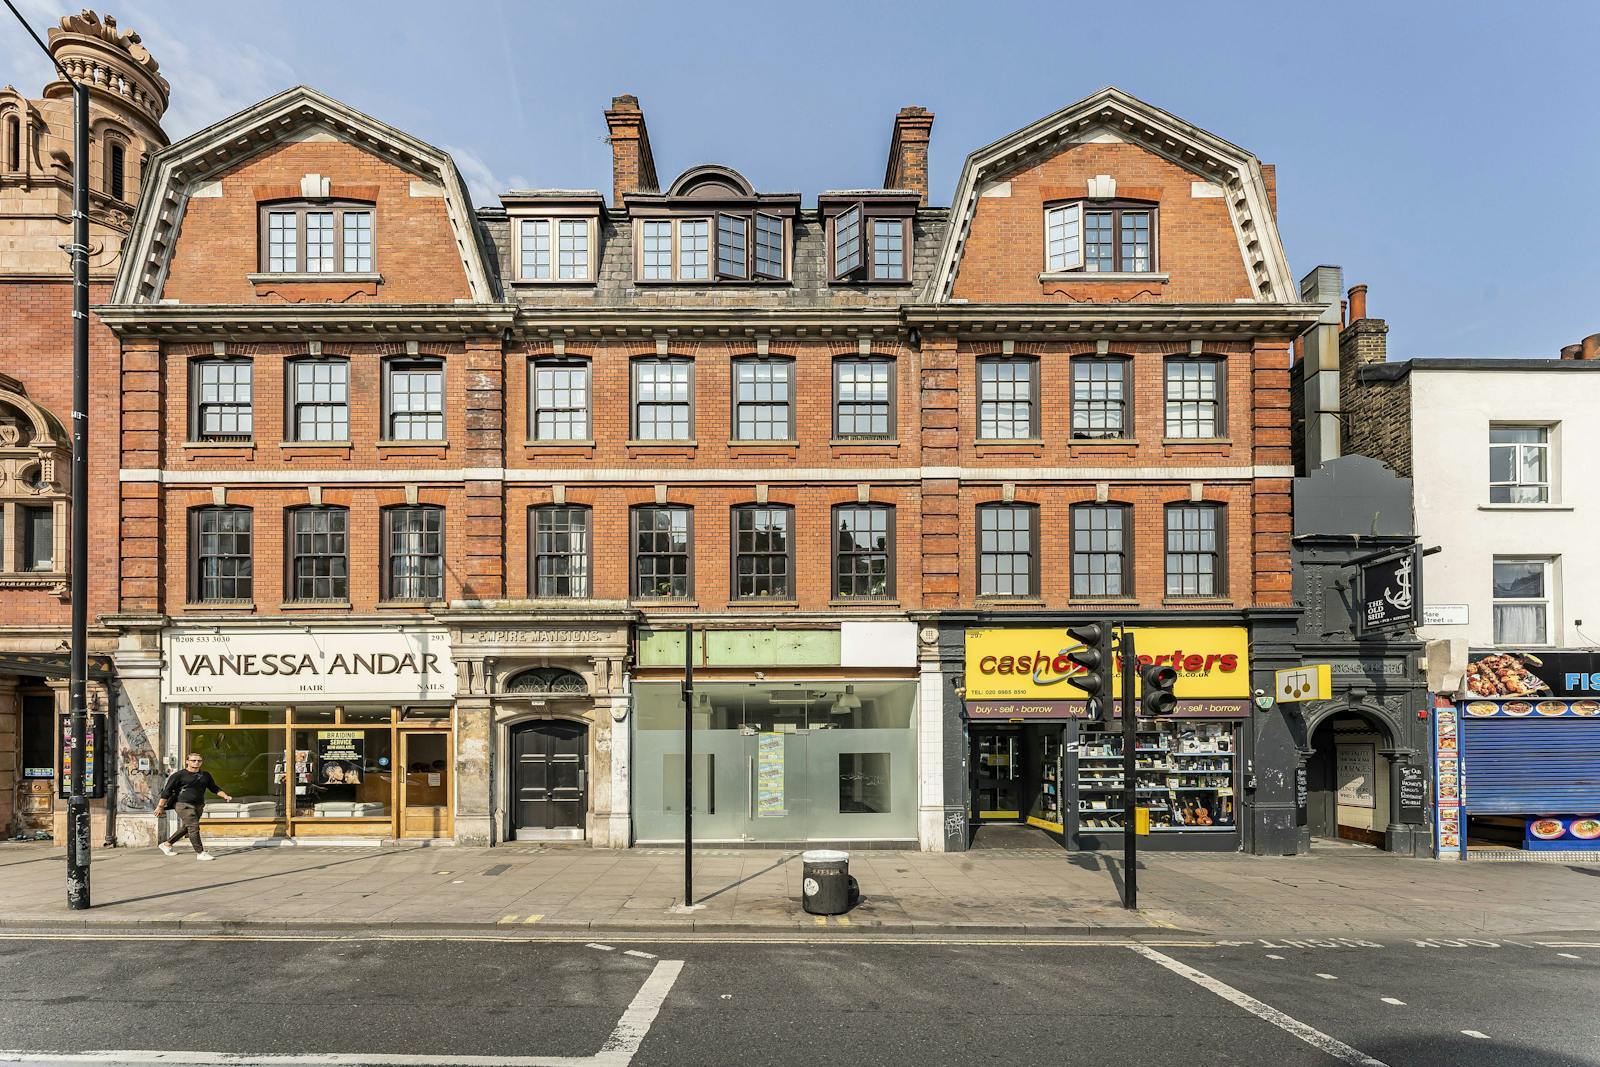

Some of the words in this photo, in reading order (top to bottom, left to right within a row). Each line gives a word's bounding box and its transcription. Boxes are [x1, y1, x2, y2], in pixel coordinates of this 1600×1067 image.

[1367, 600, 1384, 608] THE
[1367, 606, 1384, 615] OLD
[1367, 612, 1386, 621] SHIP
[478, 631, 527, 642] EMPIRE
[179, 654, 319, 676] VANESSA
[327, 653, 441, 675] ANDAR
[975, 705, 992, 714] buy
[999, 704, 1015, 713] sell
[1020, 705, 1053, 713] borrow
[1069, 705, 1086, 714] buy
[1188, 704, 1203, 712] sell
[1209, 704, 1242, 712] borrow
